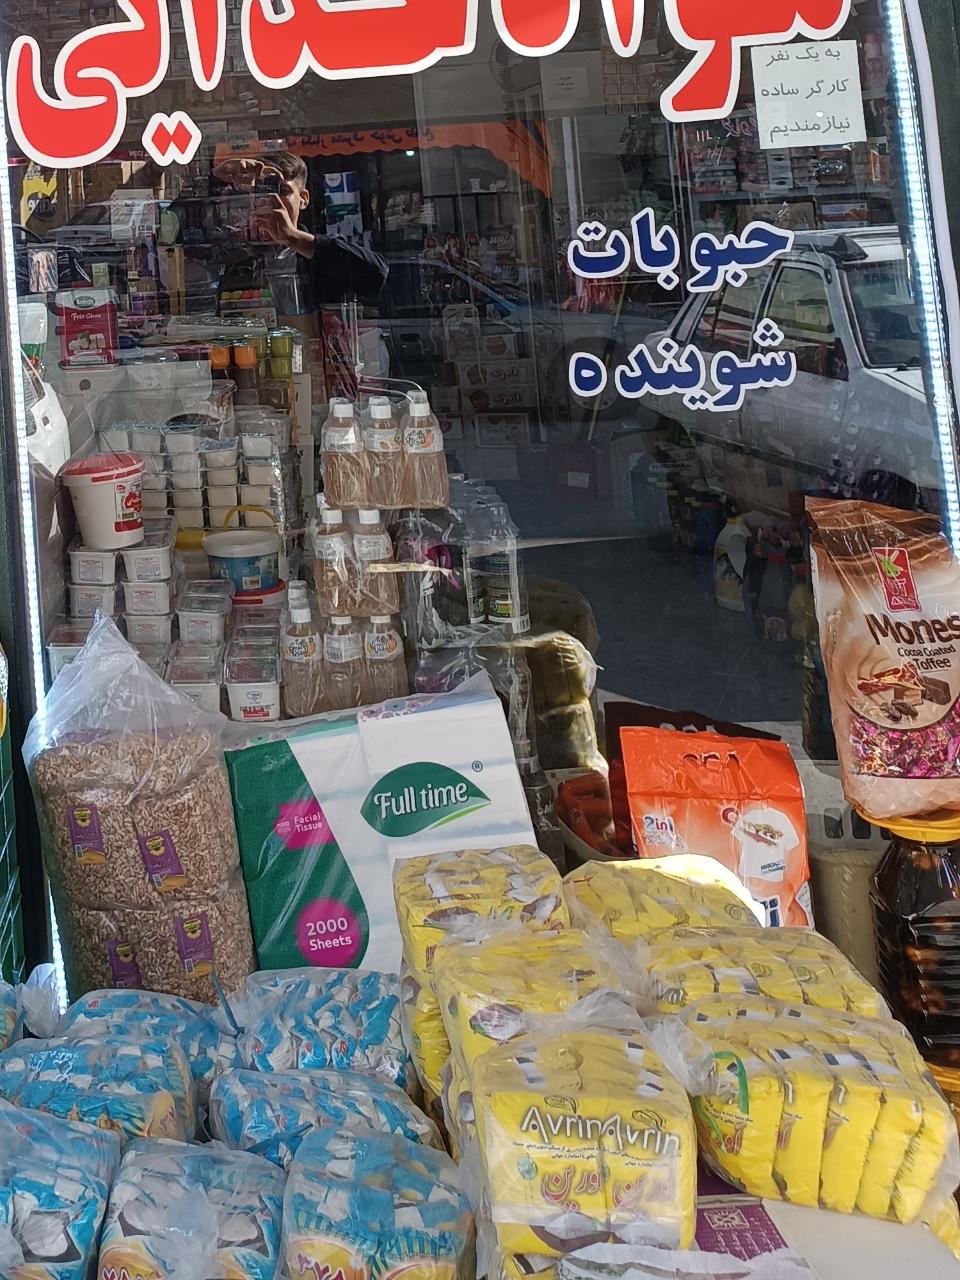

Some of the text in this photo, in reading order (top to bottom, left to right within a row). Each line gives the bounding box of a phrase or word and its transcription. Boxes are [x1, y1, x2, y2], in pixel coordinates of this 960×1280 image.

[765, 45, 841, 67] به یک نفر
[760, 78, 849, 100] کارگر ساده
[769, 116, 851, 143] نیازمندیم
[567, 207, 795, 292] حبوبات
[568, 318, 797, 412] شوینده
[897, 644, 956, 657] Cocoa Coated
[914, 657, 952, 670] Toffee
[373, 782, 470, 819] Full time
[294, 812, 321, 825] Facial
[295, 821, 323, 833] Tissue
[306, 917, 348, 937] 2000
[309, 935, 352, 952] Sheets
[520, 1106, 601, 1144] Avrin
[599, 1114, 681, 1157] Avrin
